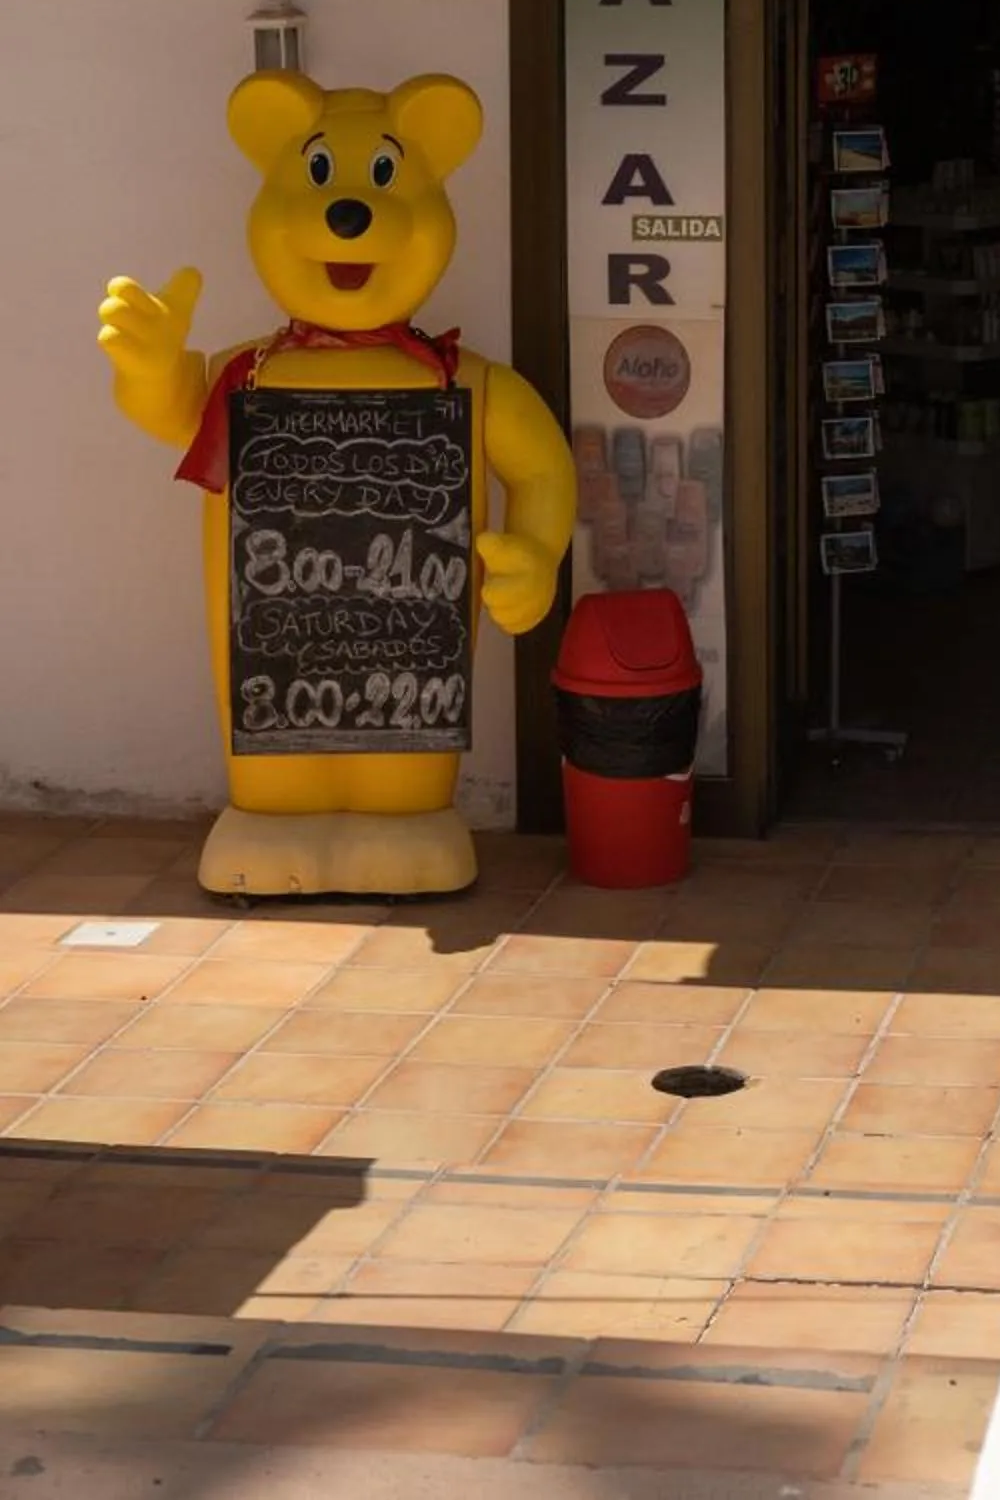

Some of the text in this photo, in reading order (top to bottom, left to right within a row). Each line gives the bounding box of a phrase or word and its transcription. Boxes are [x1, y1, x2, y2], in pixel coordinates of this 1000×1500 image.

[635, 218, 721, 238] SALIDA
[251, 408, 428, 439] SUPERMARKET
[251, 443, 346, 474] TODOS
[351, 453, 400, 476] LOS
[245, 479, 435, 513] EVERY DAY
[254, 605, 436, 640] SATURDAY
